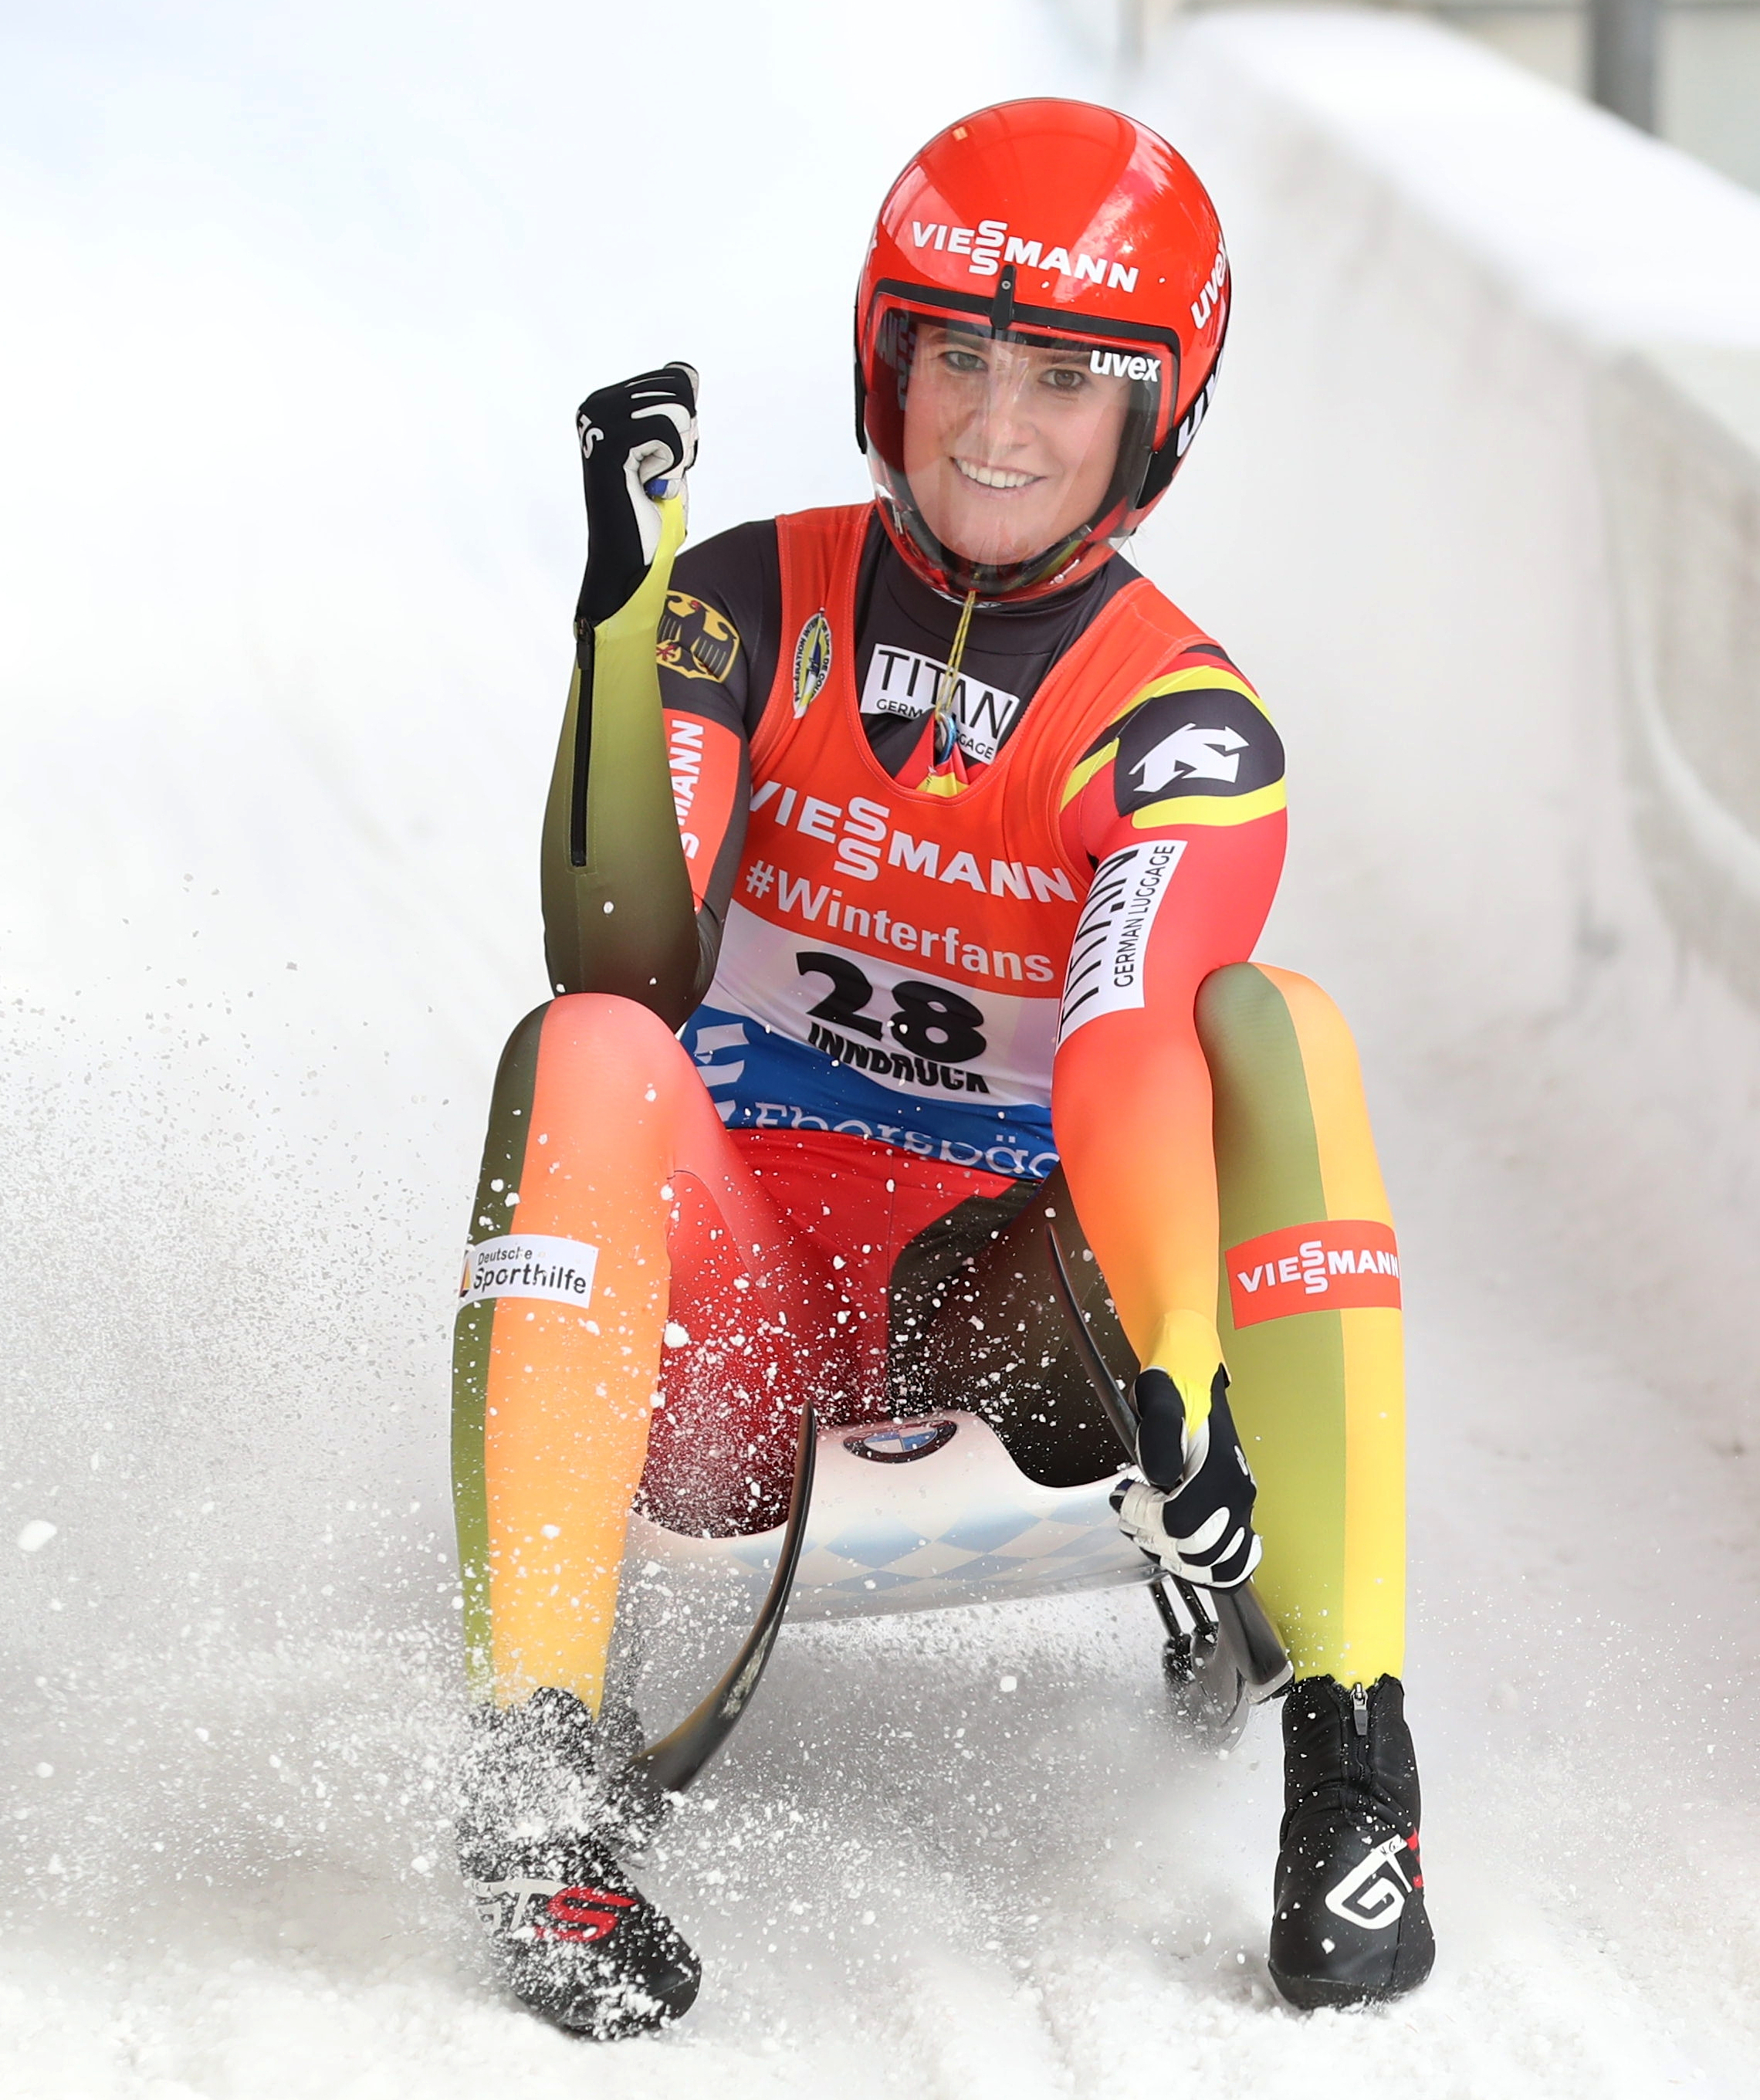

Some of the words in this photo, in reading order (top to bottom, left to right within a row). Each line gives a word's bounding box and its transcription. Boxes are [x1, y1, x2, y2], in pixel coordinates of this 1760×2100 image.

[912, 219, 1139, 293] VIESSMANN
[1088, 349, 1162, 383] uvex
[875, 698, 923, 718] GERM
[956, 731, 994, 760] GAGE
[878, 649, 1014, 740] TITAN
[745, 859, 1055, 984] #Winterfans
[1113, 918, 1145, 988] GERMAN
[795, 950, 987, 1064] 28
[472, 1262, 587, 1295] Sporthilfe
[1236, 1239, 1400, 1296] VIESSMANN
[1325, 1827, 1423, 1930] GT
